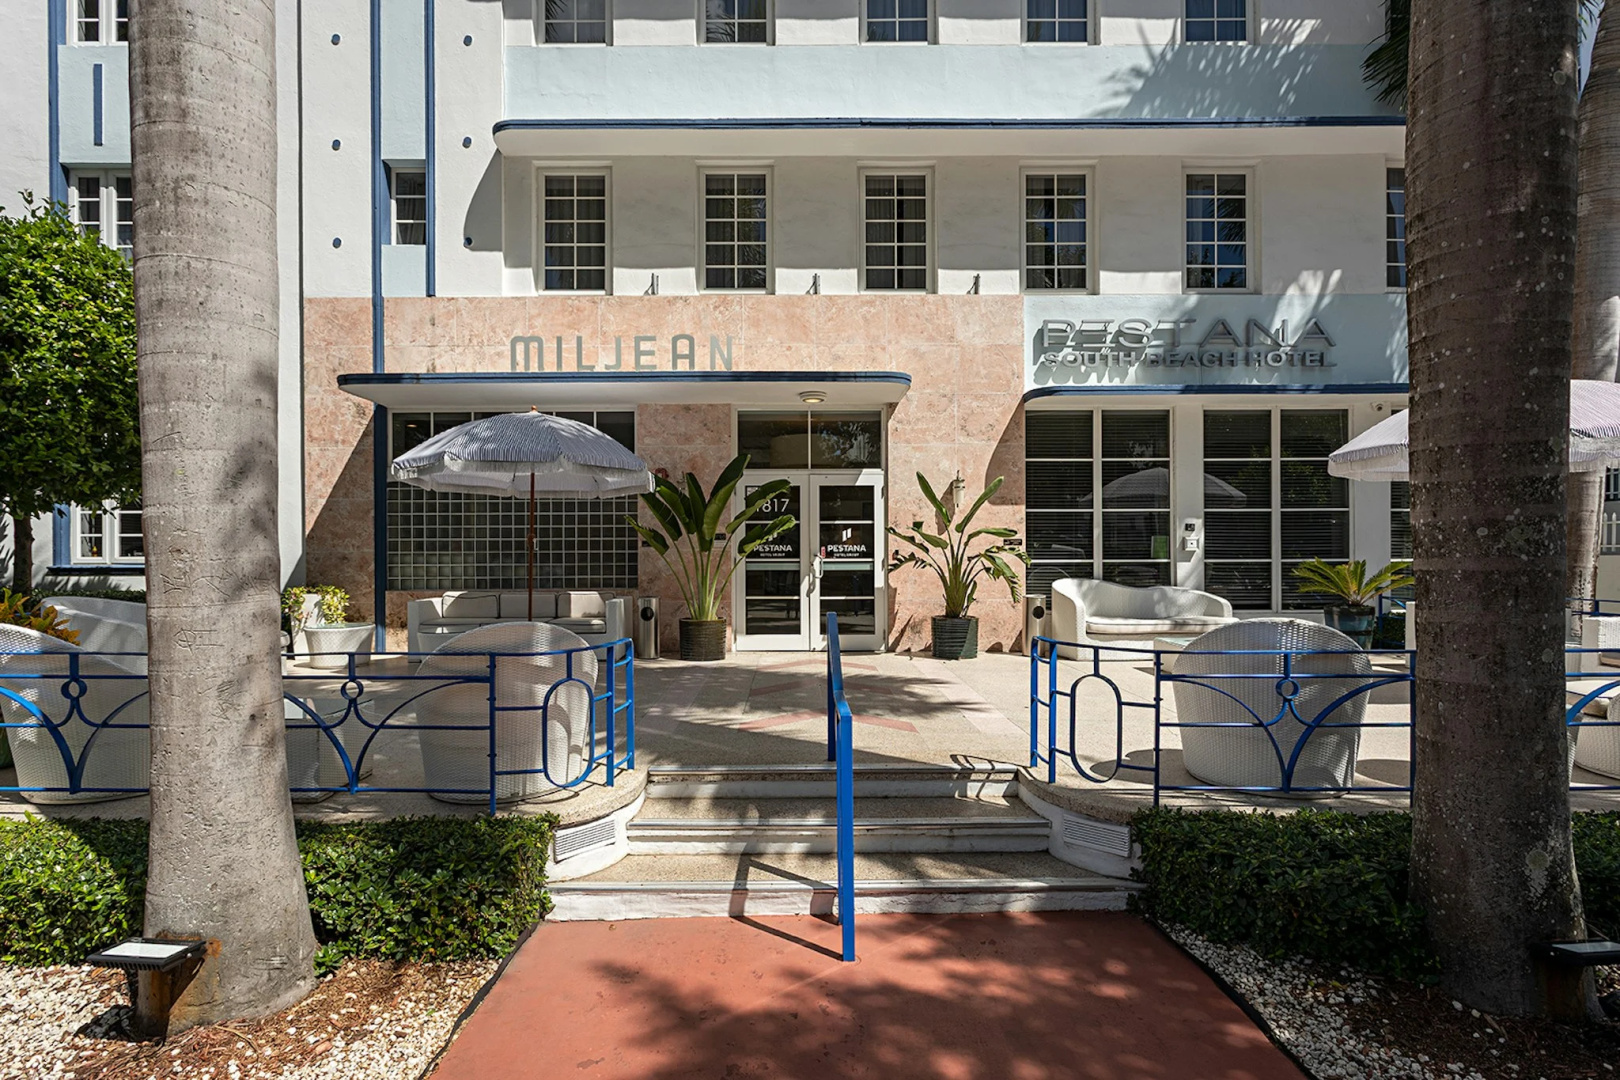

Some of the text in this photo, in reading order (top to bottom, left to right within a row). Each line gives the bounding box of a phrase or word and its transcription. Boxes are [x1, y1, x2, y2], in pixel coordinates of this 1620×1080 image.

[1042, 318, 1336, 348] PESTANA
[510, 334, 733, 371] MILJEAN
[1043, 351, 1337, 367] SOUTH BEACH HOTEL
[756, 498, 790, 512] 817
[753, 544, 793, 552] PESTANA
[827, 544, 867, 552] PESTANA
